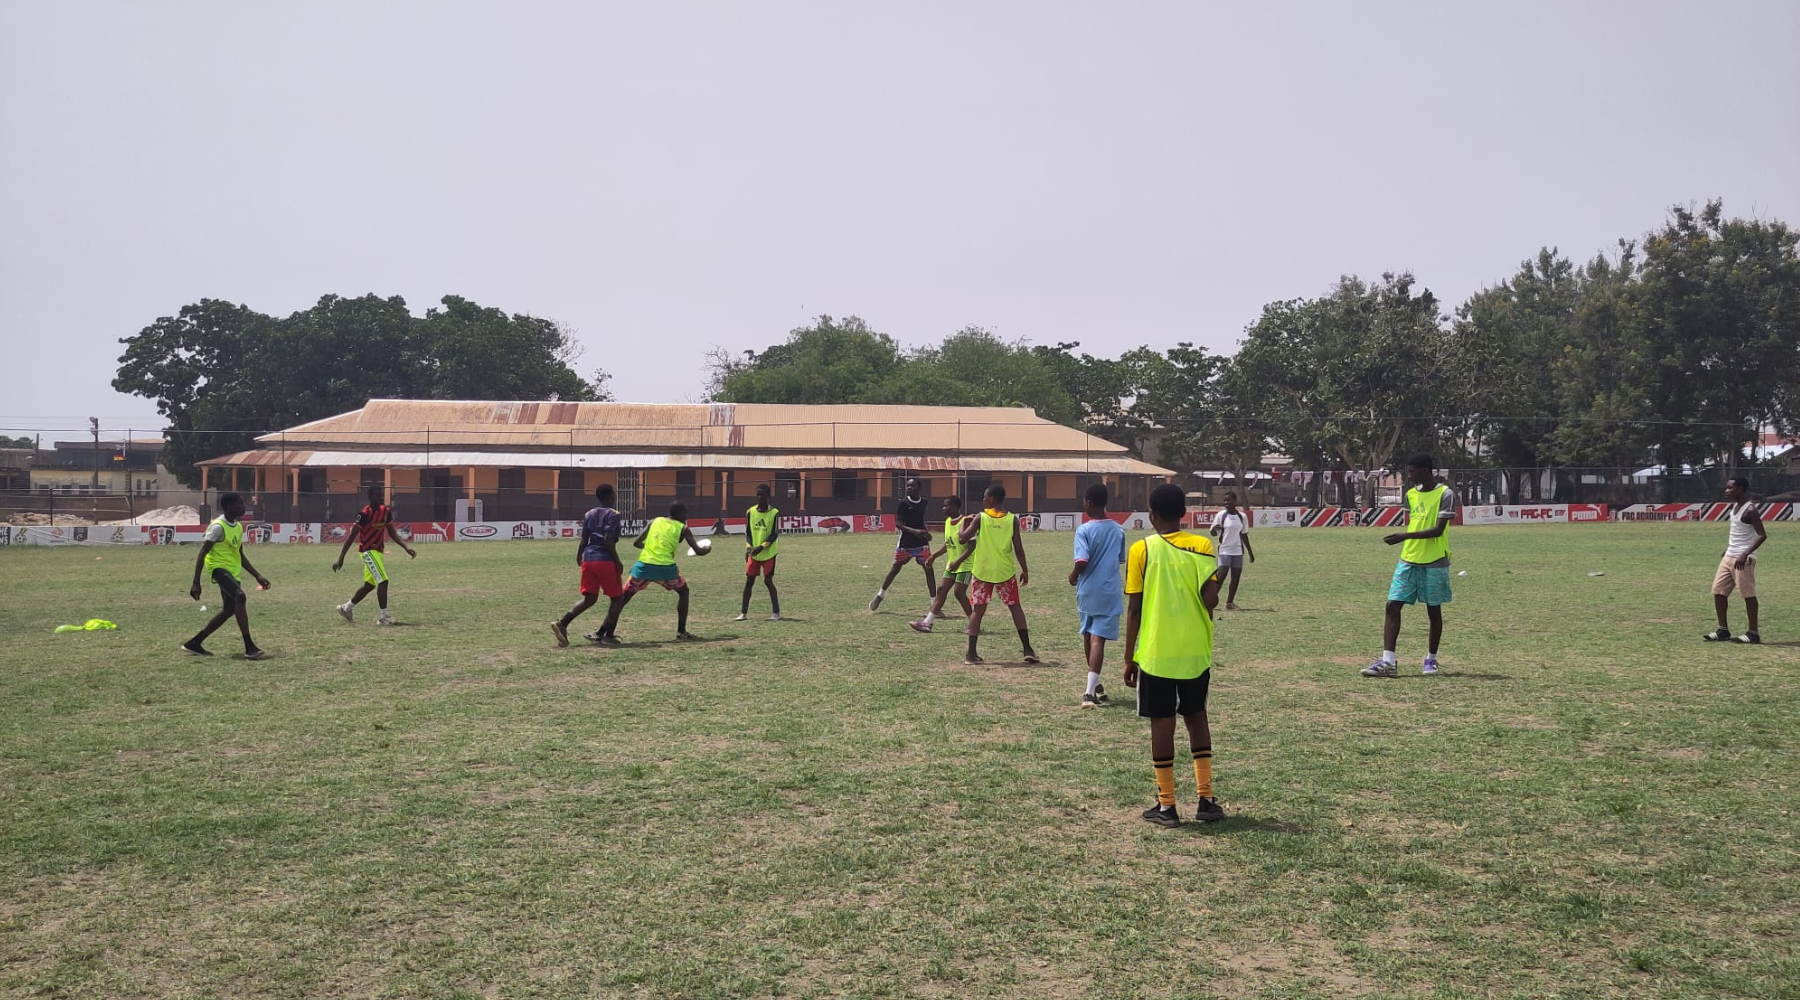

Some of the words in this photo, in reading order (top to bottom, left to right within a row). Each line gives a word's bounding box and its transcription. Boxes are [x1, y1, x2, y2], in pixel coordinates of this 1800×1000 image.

[1196, 514, 1208, 522] WE
[1572, 511, 1597, 520] PUMA
[621, 527, 644, 536] CHAMP
